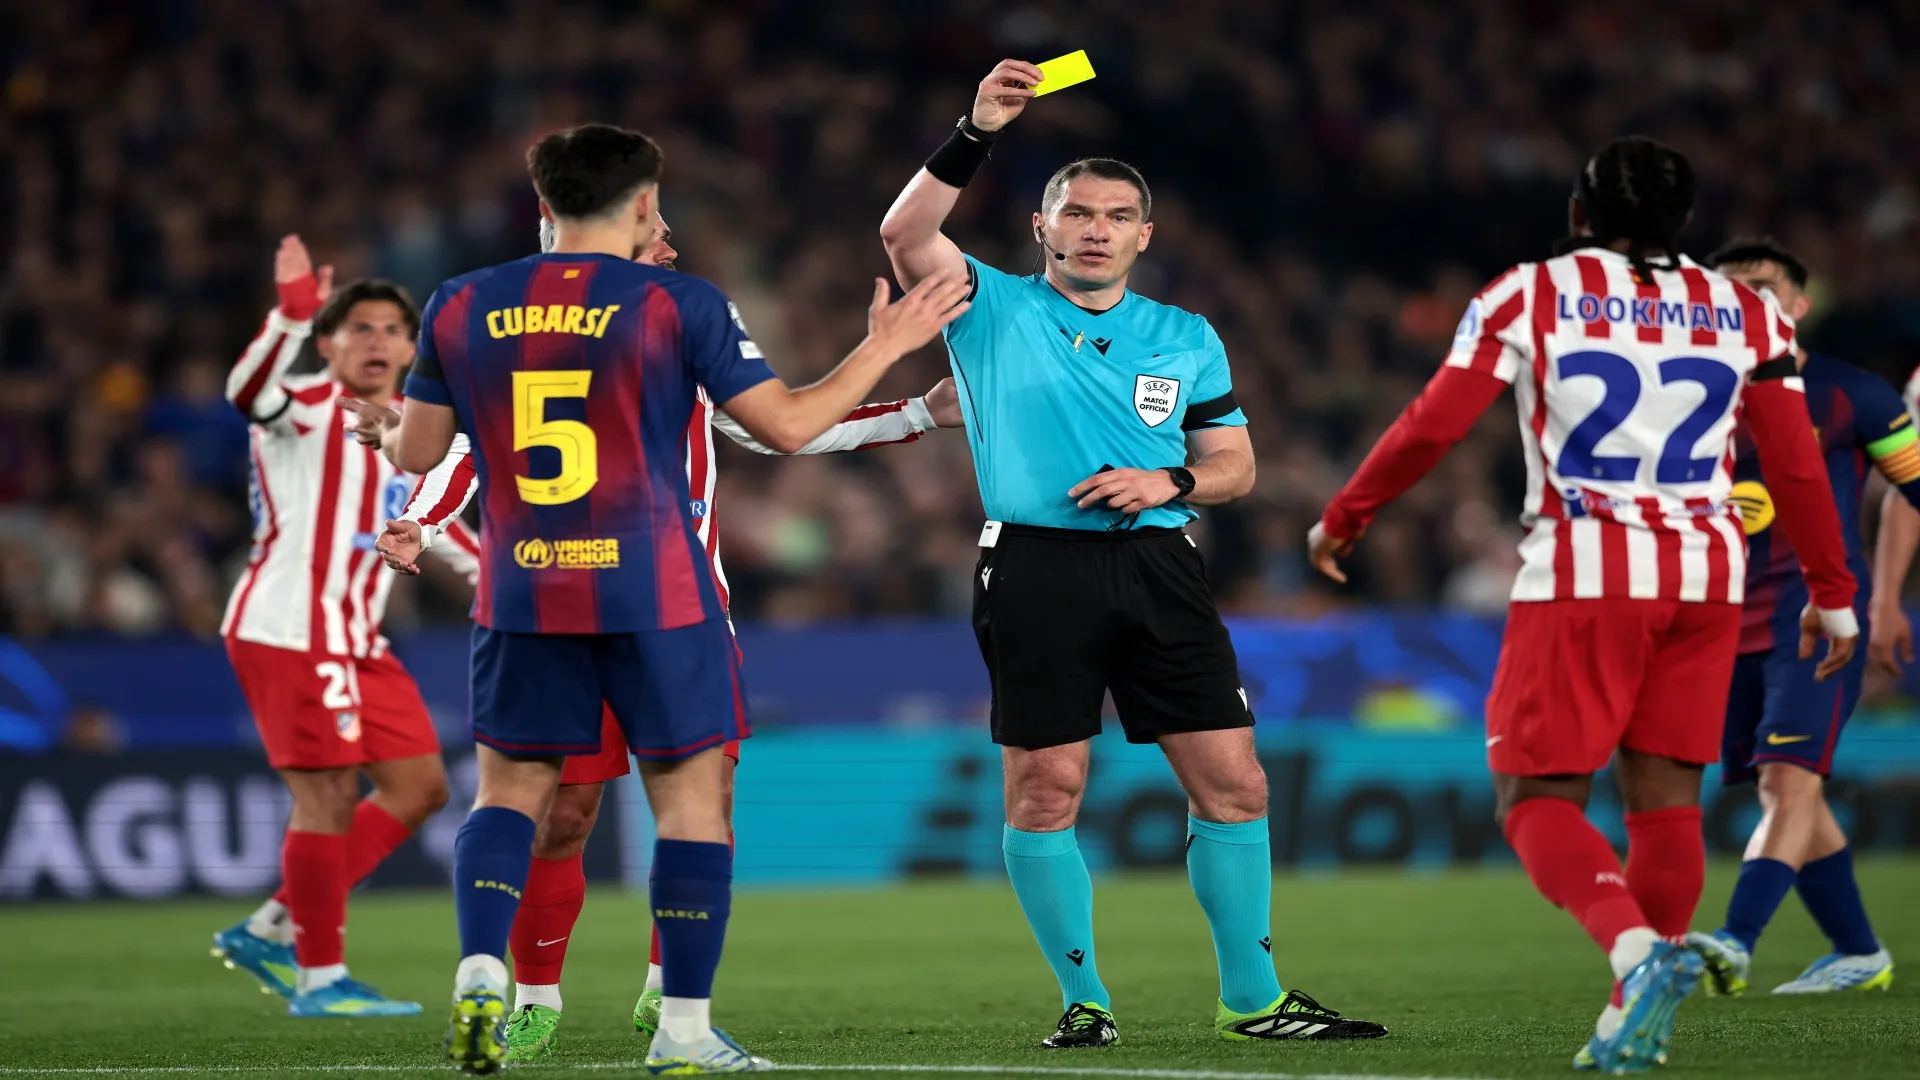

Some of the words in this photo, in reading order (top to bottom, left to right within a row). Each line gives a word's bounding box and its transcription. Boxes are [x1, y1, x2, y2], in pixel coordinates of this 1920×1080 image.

[1558, 294, 1742, 331] LOOKMAN
[486, 304, 621, 339] CUBARSÍ
[1145, 383, 1170, 393] UEFA
[1143, 396, 1168, 405] MATCH
[1139, 403, 1169, 413] OFFICIAL
[1557, 350, 1738, 484] 22
[512, 370, 598, 505] 5
[554, 538, 619, 552] UNHCR
[557, 551, 620, 564] ACNUR
